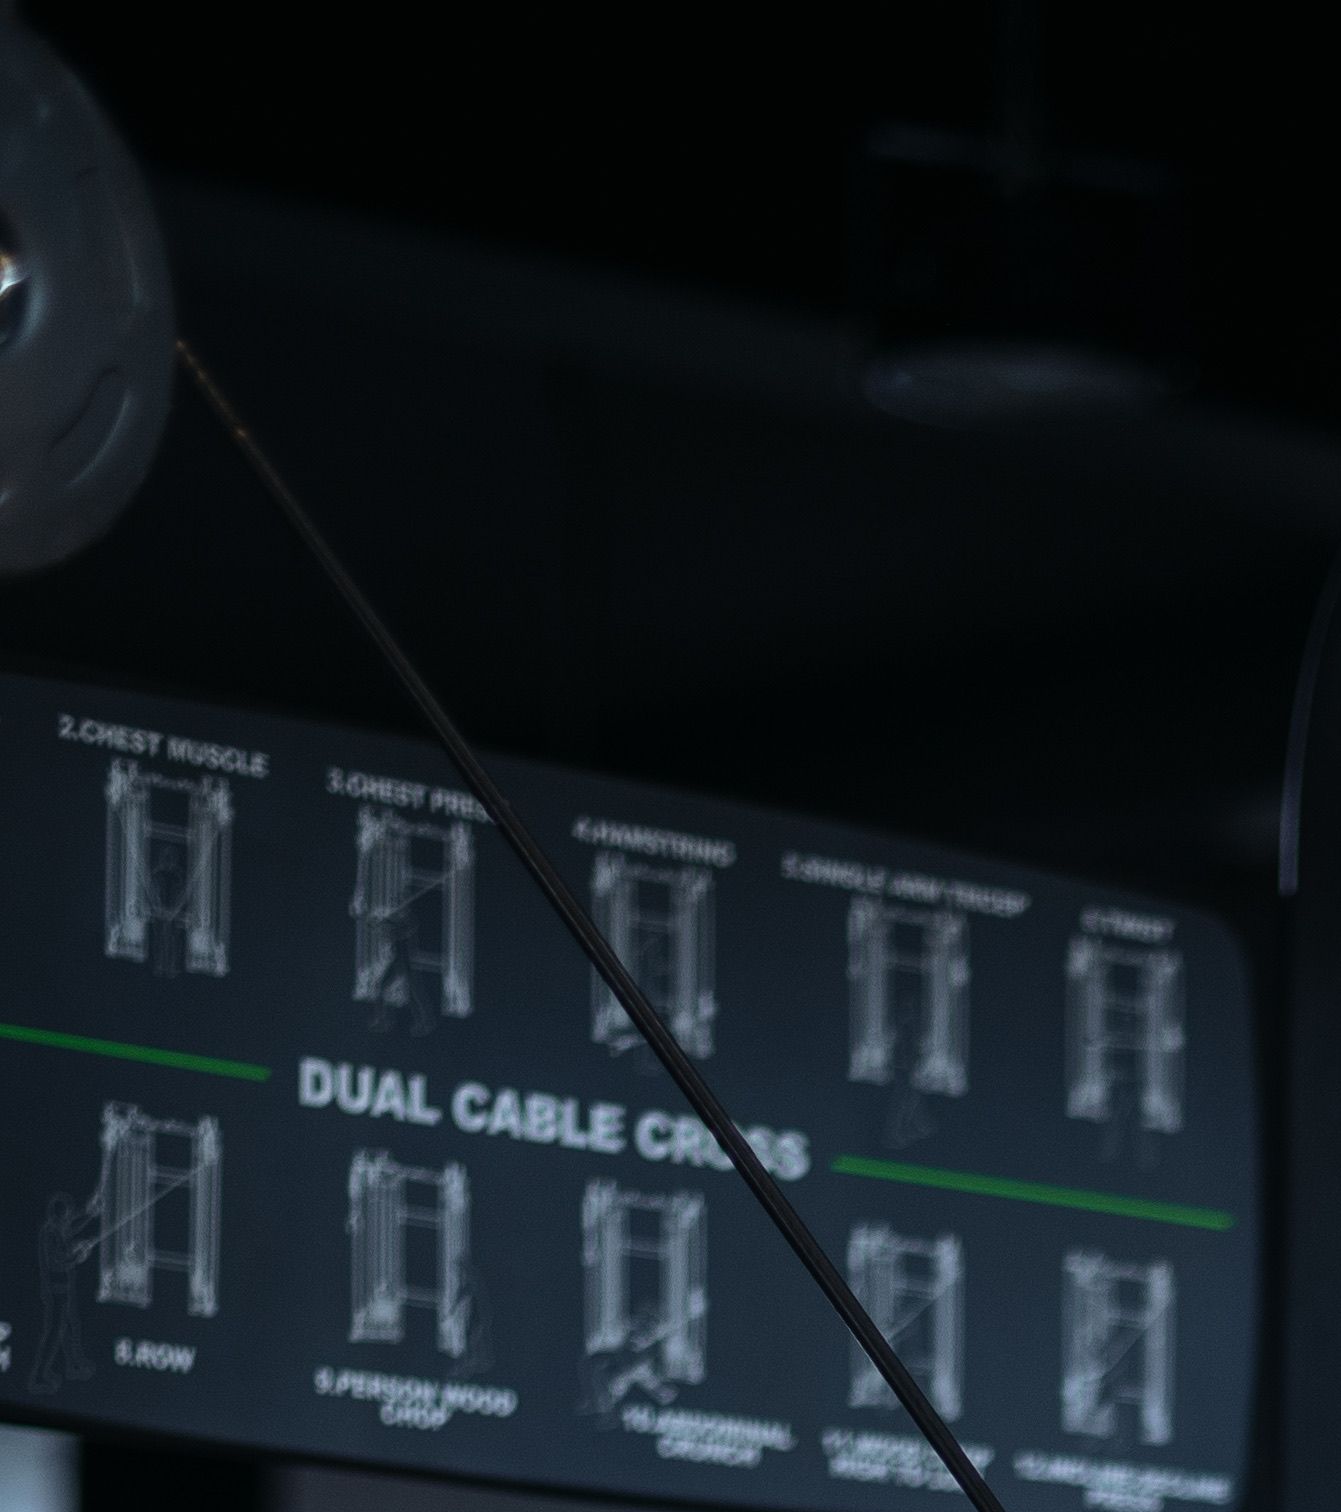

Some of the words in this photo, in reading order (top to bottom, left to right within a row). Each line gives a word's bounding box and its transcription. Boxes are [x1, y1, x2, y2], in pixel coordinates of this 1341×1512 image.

[57, 713, 165, 757] 2.CHEST
[167, 734, 271, 779] MUSCLE
[326, 765, 427, 809] 3.CHEST
[299, 1055, 443, 1127] DUAL
[450, 1080, 630, 1156] CABLE
[633, 1109, 811, 1183] CROSS
[113, 1335, 197, 1374] 8.ROW
